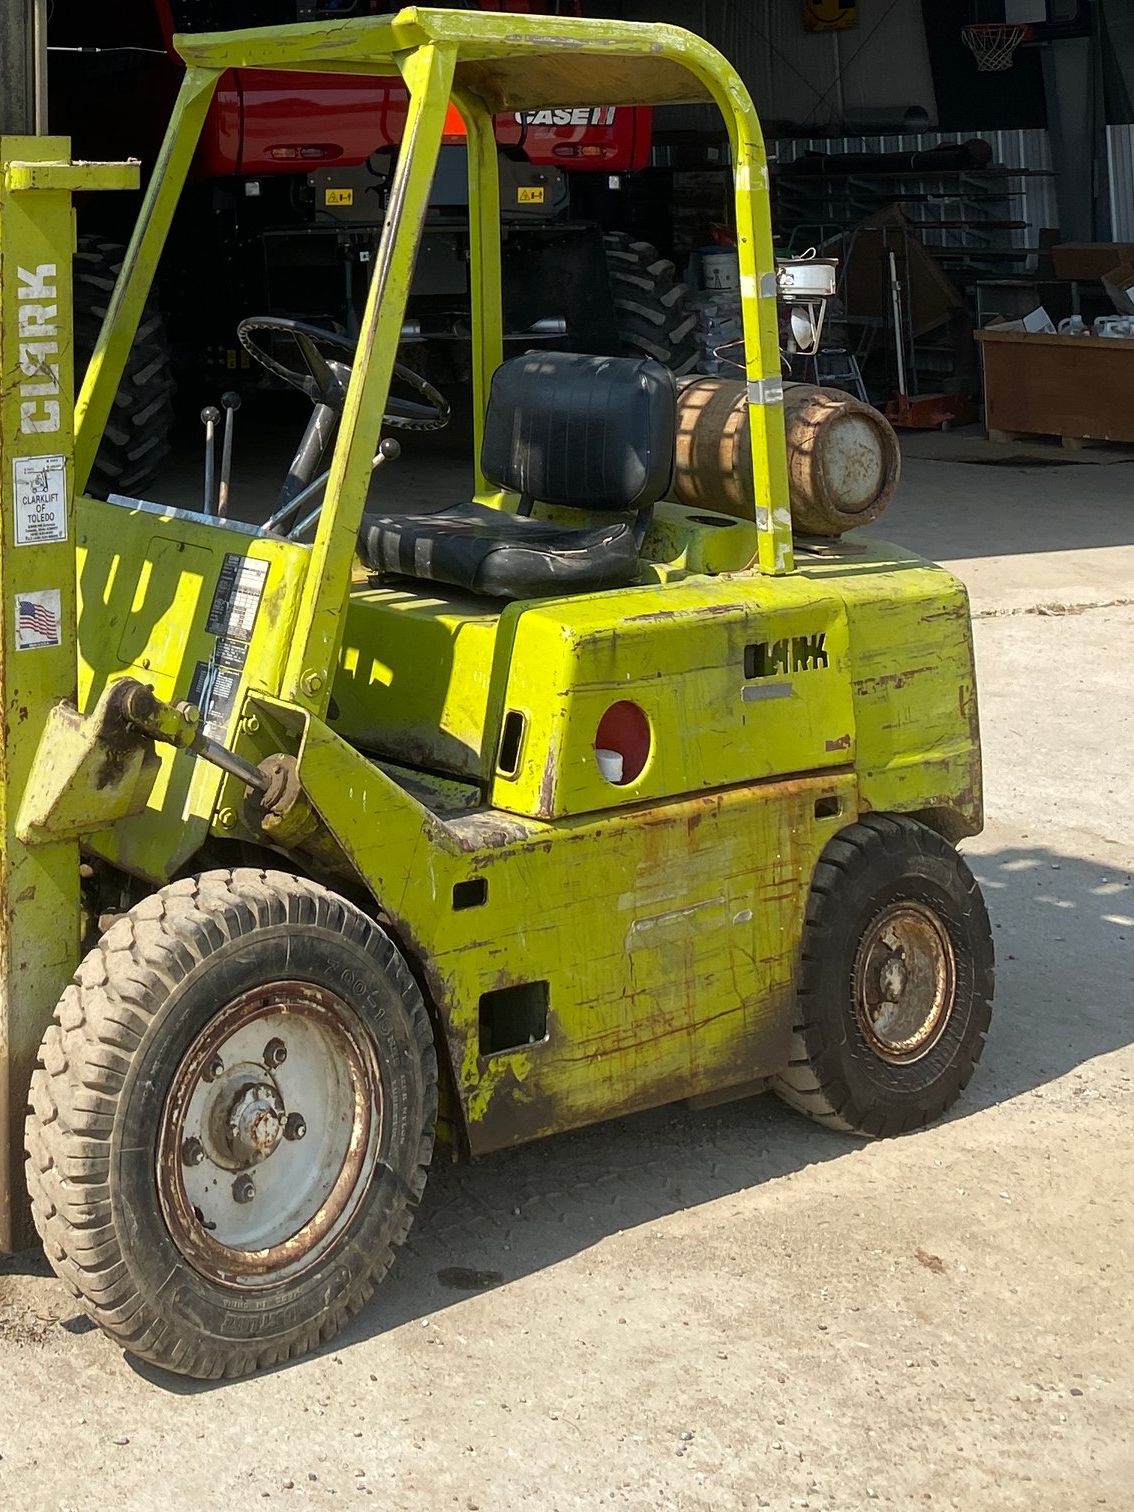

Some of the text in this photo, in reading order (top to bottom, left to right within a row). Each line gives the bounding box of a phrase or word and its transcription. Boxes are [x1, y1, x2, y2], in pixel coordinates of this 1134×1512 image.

[17, 263, 60, 434] CLARK
[22, 493, 59, 505] CLARKLIFT
[35, 504, 46, 513] OF
[27, 512, 55, 523] TOLEDO
